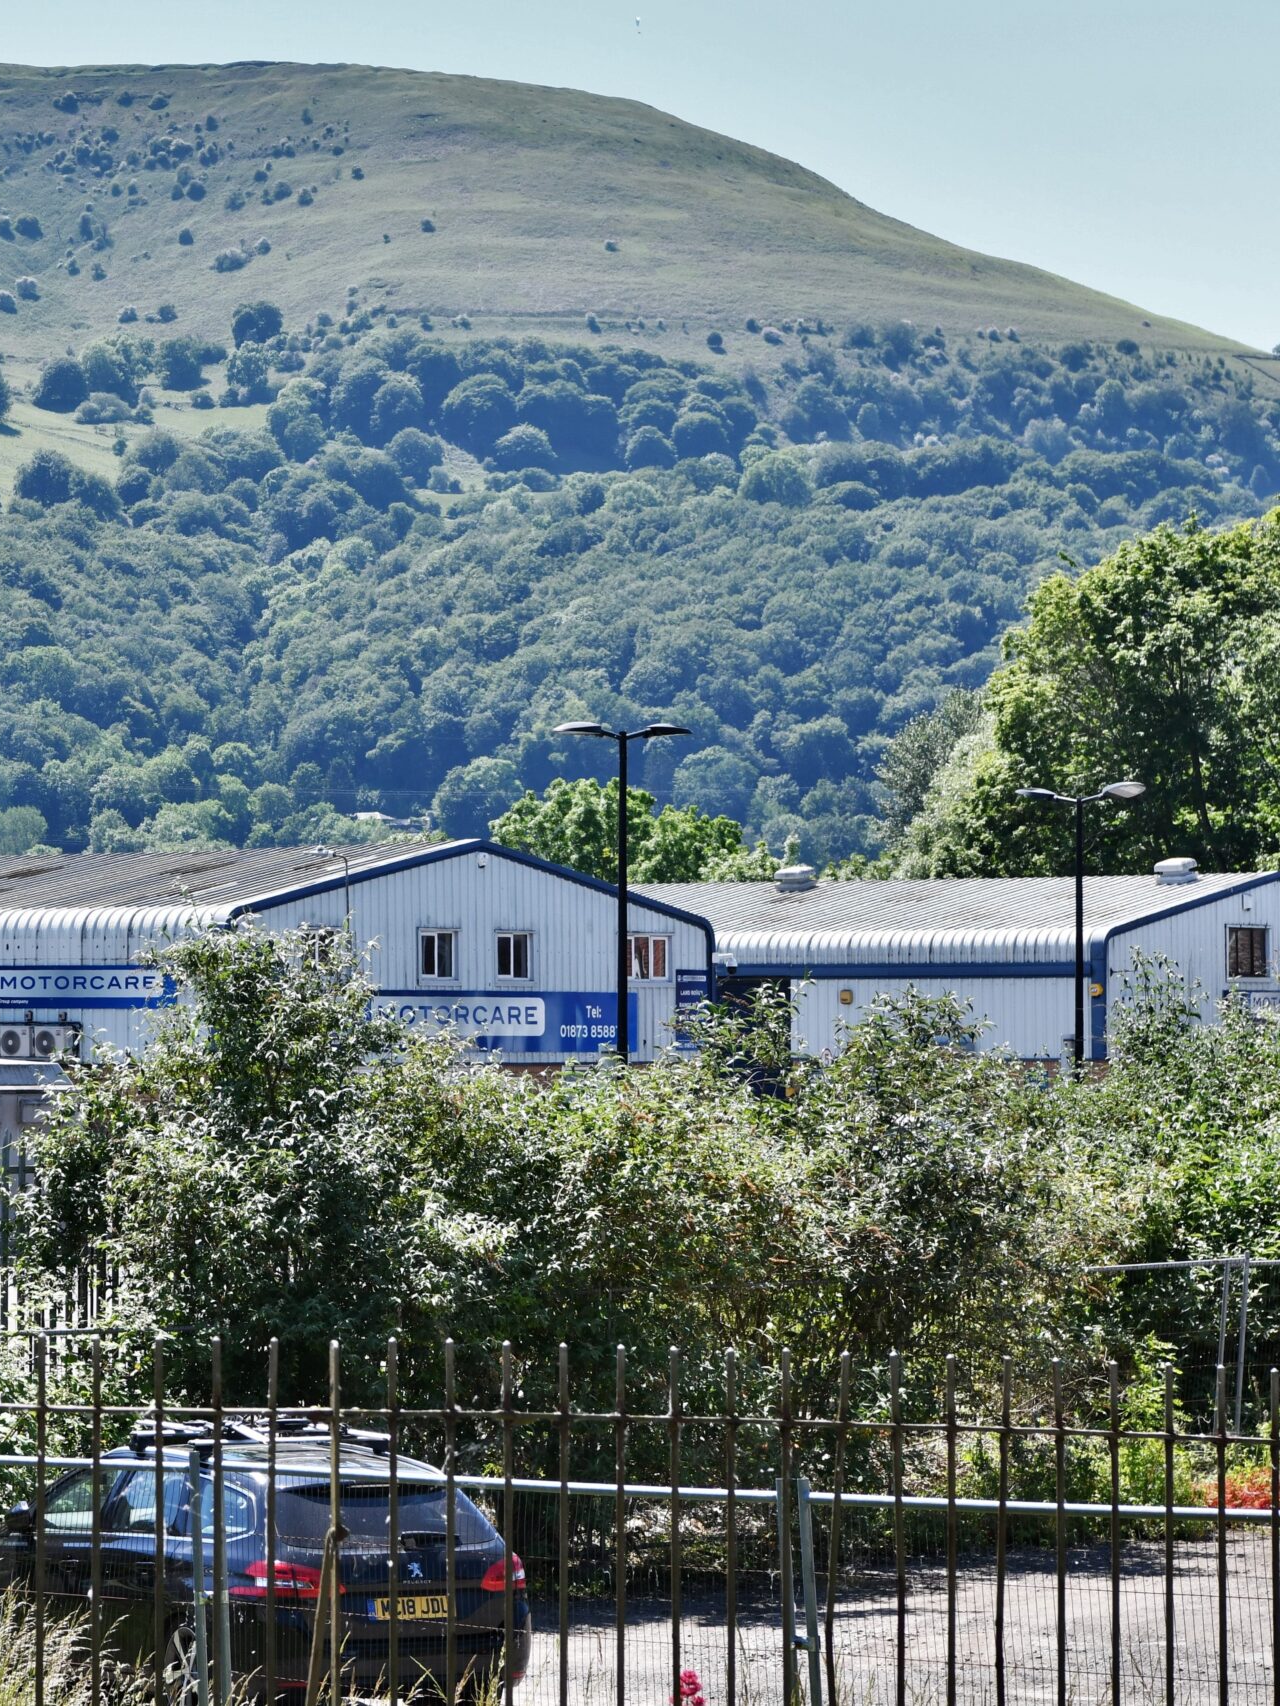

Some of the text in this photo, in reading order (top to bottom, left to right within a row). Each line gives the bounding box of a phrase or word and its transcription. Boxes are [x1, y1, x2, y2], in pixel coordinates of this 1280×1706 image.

[0, 975, 157, 990] MOTORCARE
[585, 1005, 602, 1018] Tel:
[560, 1025, 618, 1038] 01873 8588
